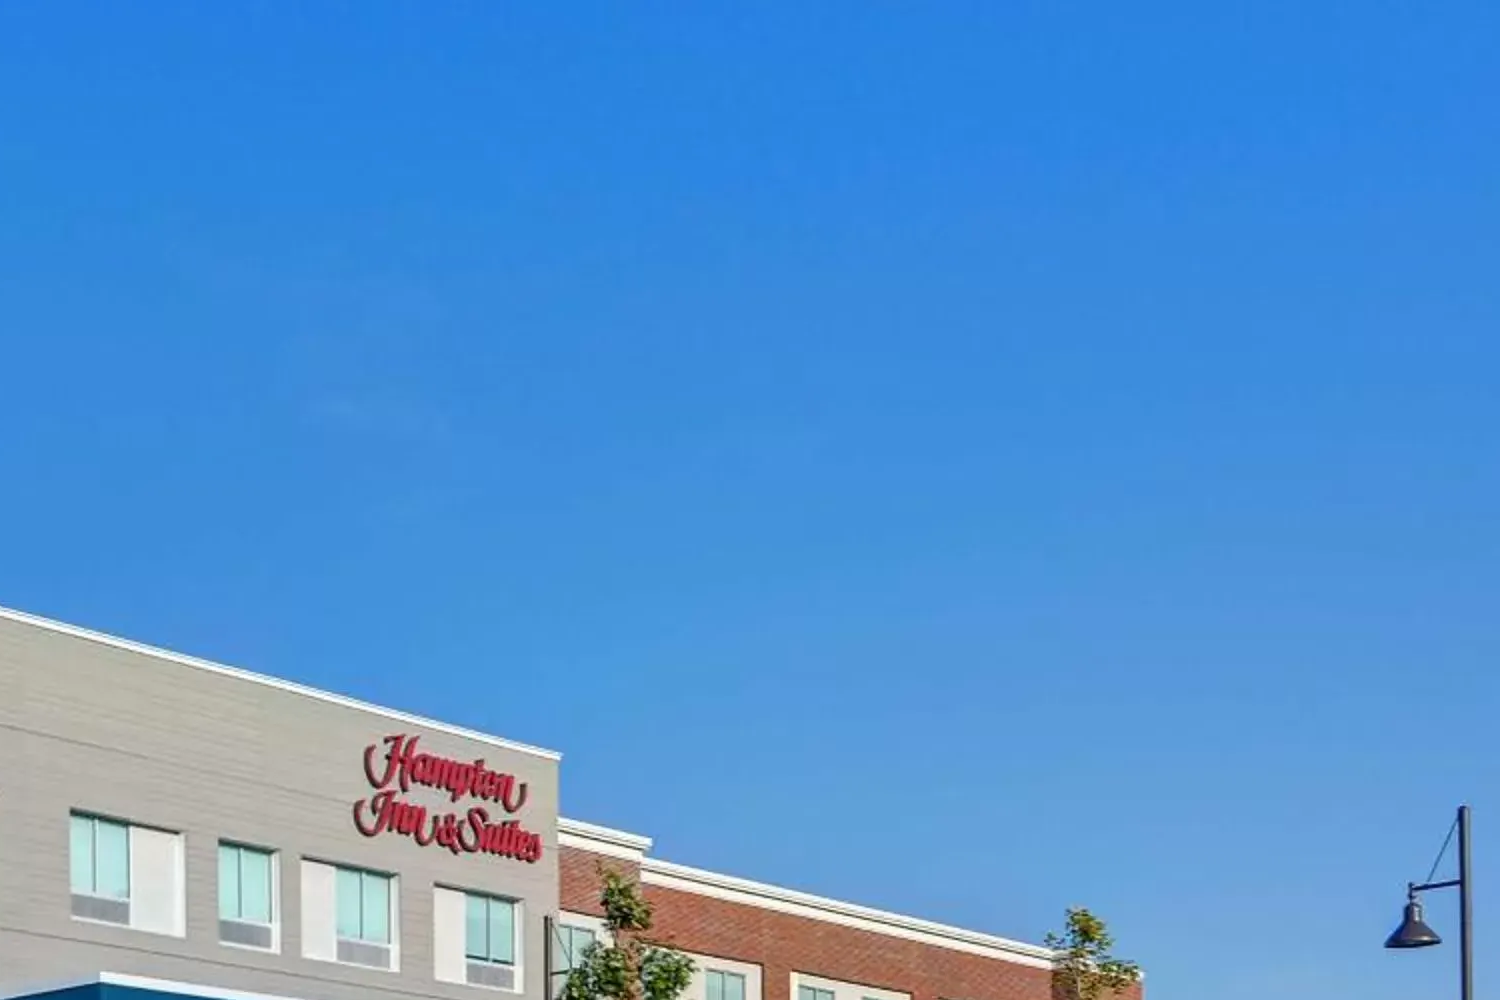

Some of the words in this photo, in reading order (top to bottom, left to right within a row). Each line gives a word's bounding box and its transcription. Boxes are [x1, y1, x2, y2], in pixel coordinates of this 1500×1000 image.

[364, 734, 528, 813] Hampton
[353, 790, 439, 846] Inn
[457, 806, 543, 863] Suites
